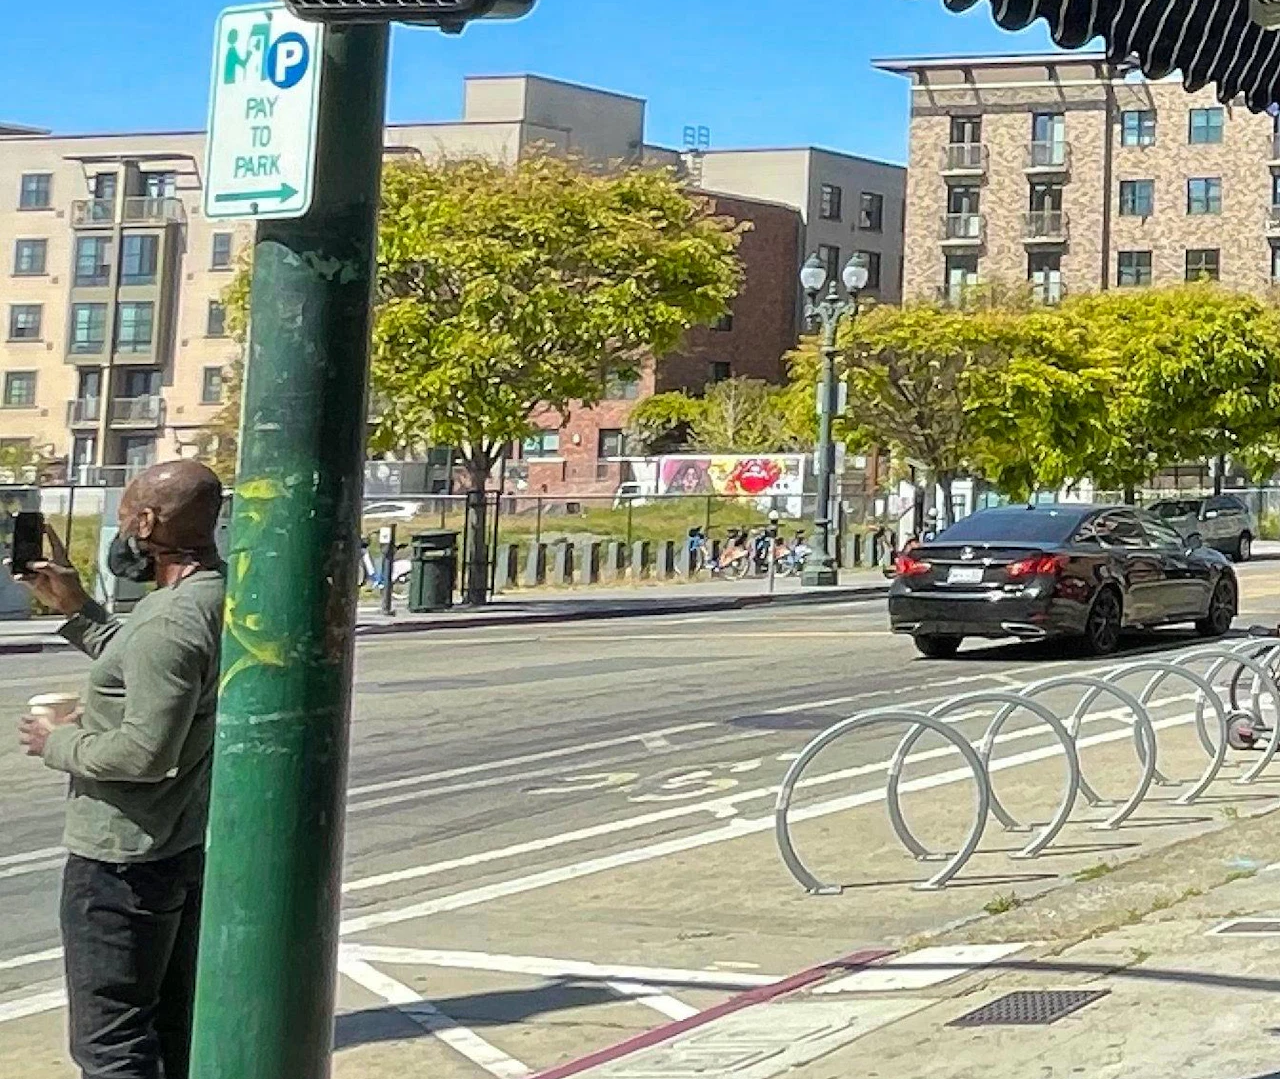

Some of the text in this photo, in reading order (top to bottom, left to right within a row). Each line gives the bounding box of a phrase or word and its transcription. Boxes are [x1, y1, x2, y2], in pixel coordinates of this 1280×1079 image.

[275, 41, 303, 82] P
[245, 95, 279, 119] PAY
[251, 126, 271, 147] TO
[233, 154, 281, 178] PARK
